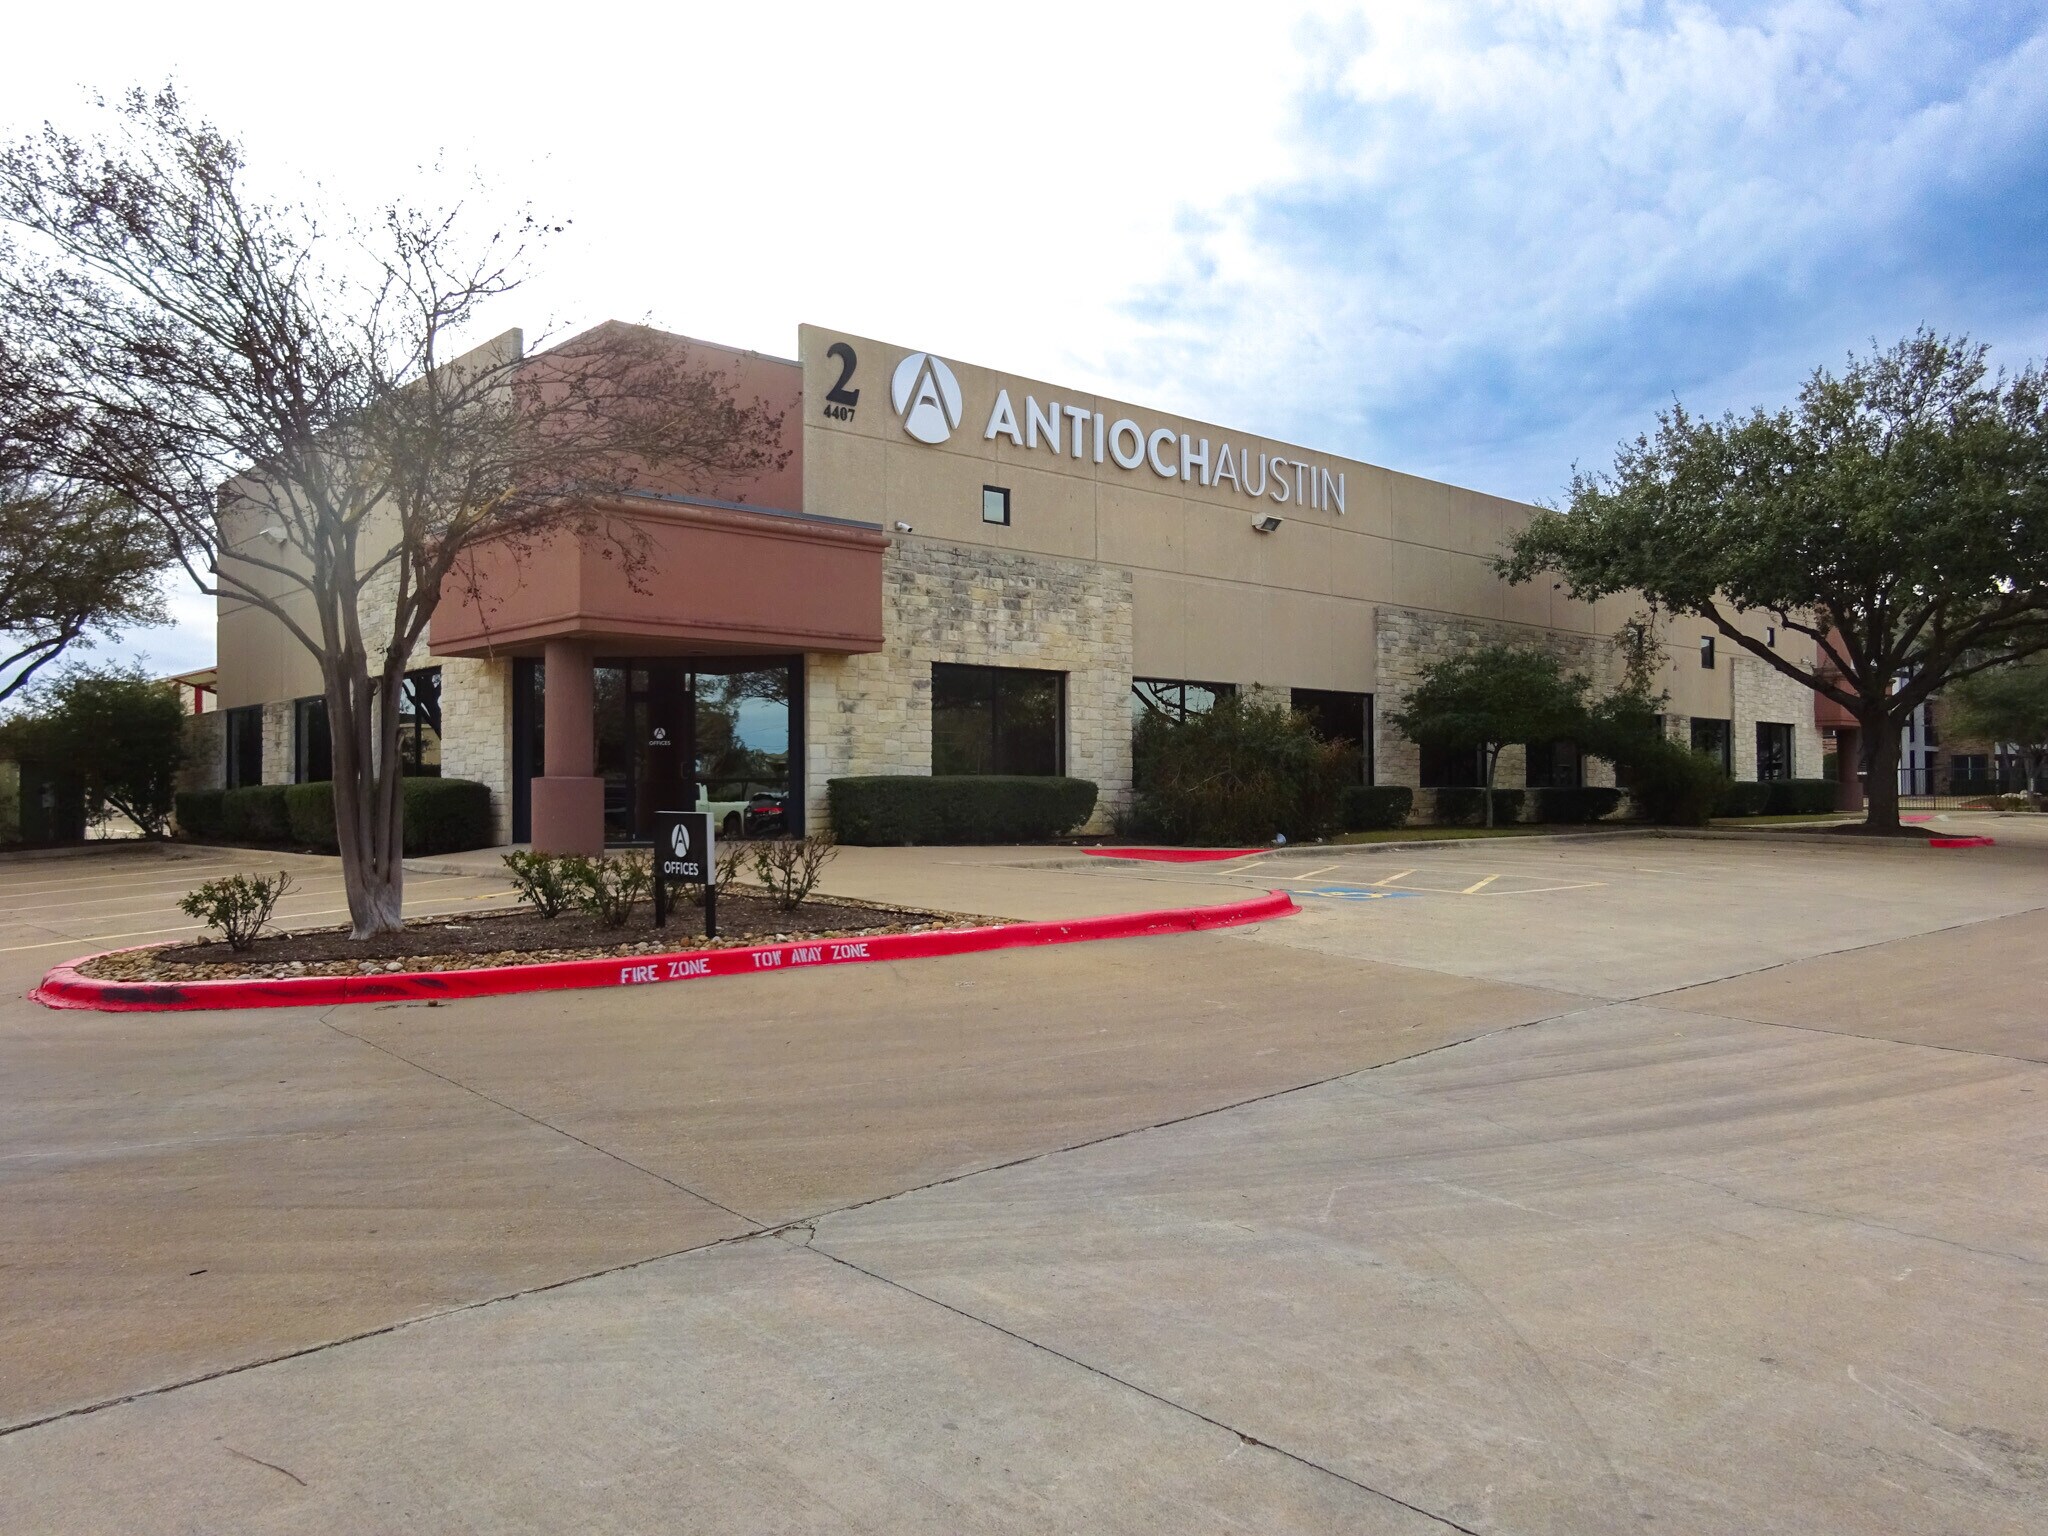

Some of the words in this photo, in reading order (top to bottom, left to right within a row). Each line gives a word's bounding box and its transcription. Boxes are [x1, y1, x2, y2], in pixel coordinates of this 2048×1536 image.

[826, 342, 860, 407] 2
[823, 405, 855, 422] 4407
[664, 861, 699, 876] OFFICES
[752, 950, 782, 967] TOW
[791, 947, 821, 964] AWAY
[830, 943, 870, 960] ZONE
[621, 964, 660, 984] FIRE
[668, 958, 711, 978] ZONE
